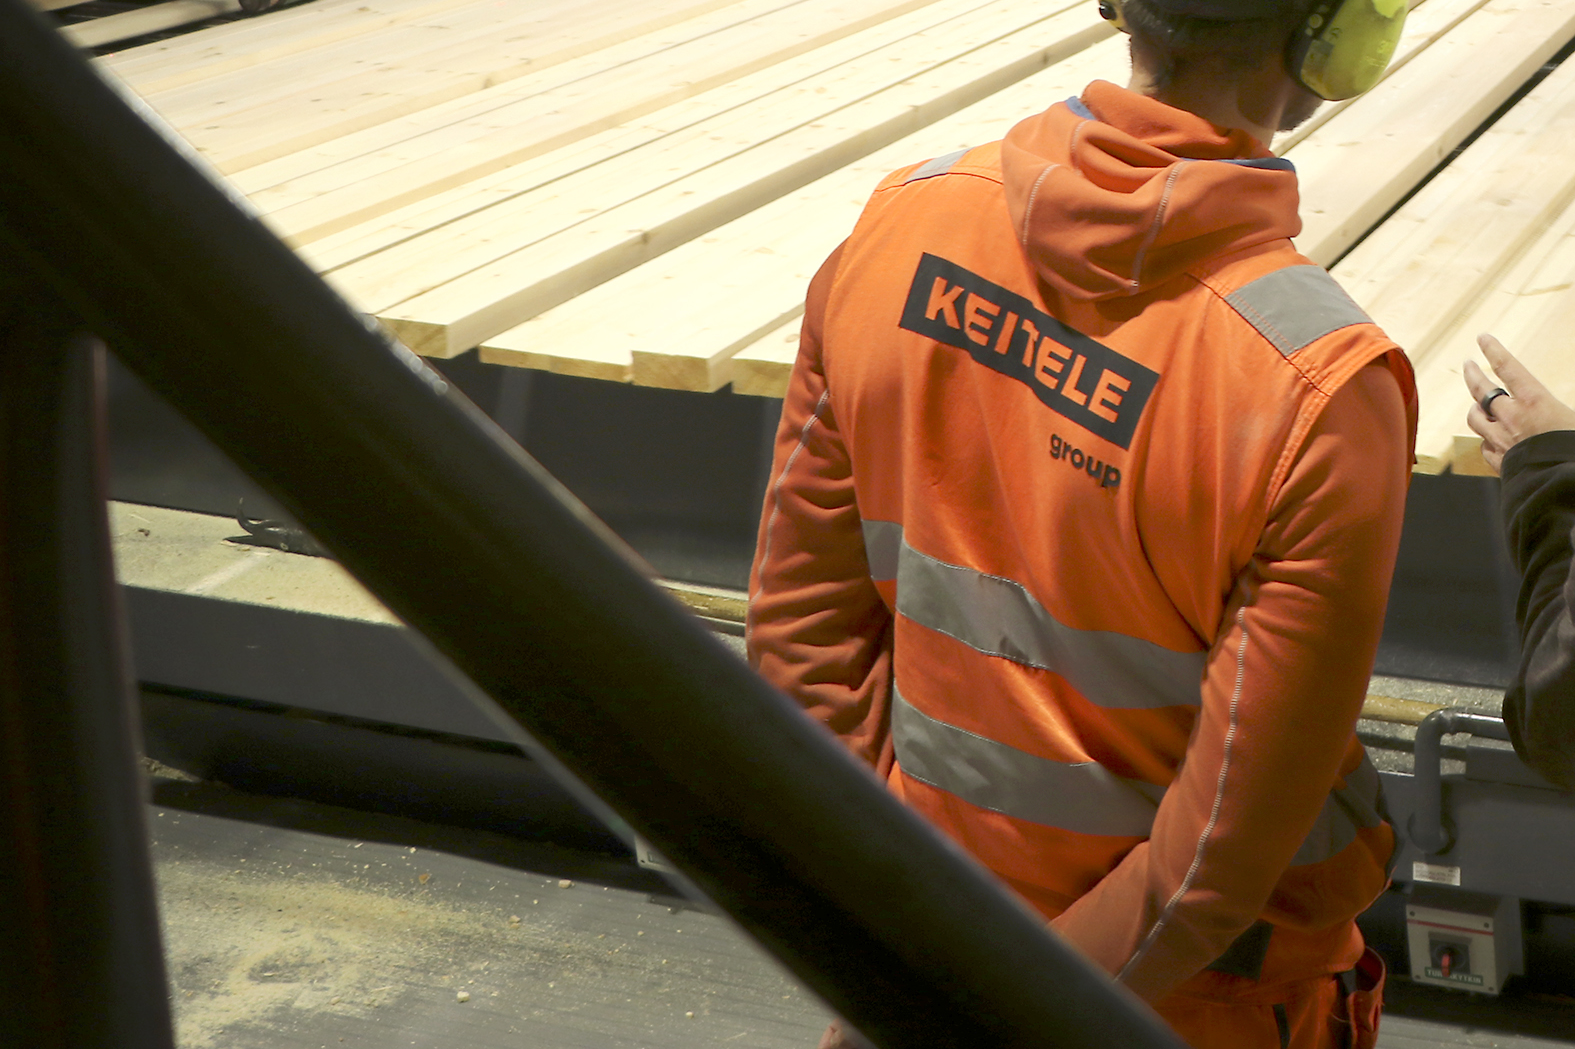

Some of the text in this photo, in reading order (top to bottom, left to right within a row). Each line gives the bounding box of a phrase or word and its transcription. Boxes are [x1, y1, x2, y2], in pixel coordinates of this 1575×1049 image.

[925, 276, 1131, 423] KEITELE
[1050, 433, 1121, 487] group
[1427, 969, 1481, 983] TURKYTKIN
